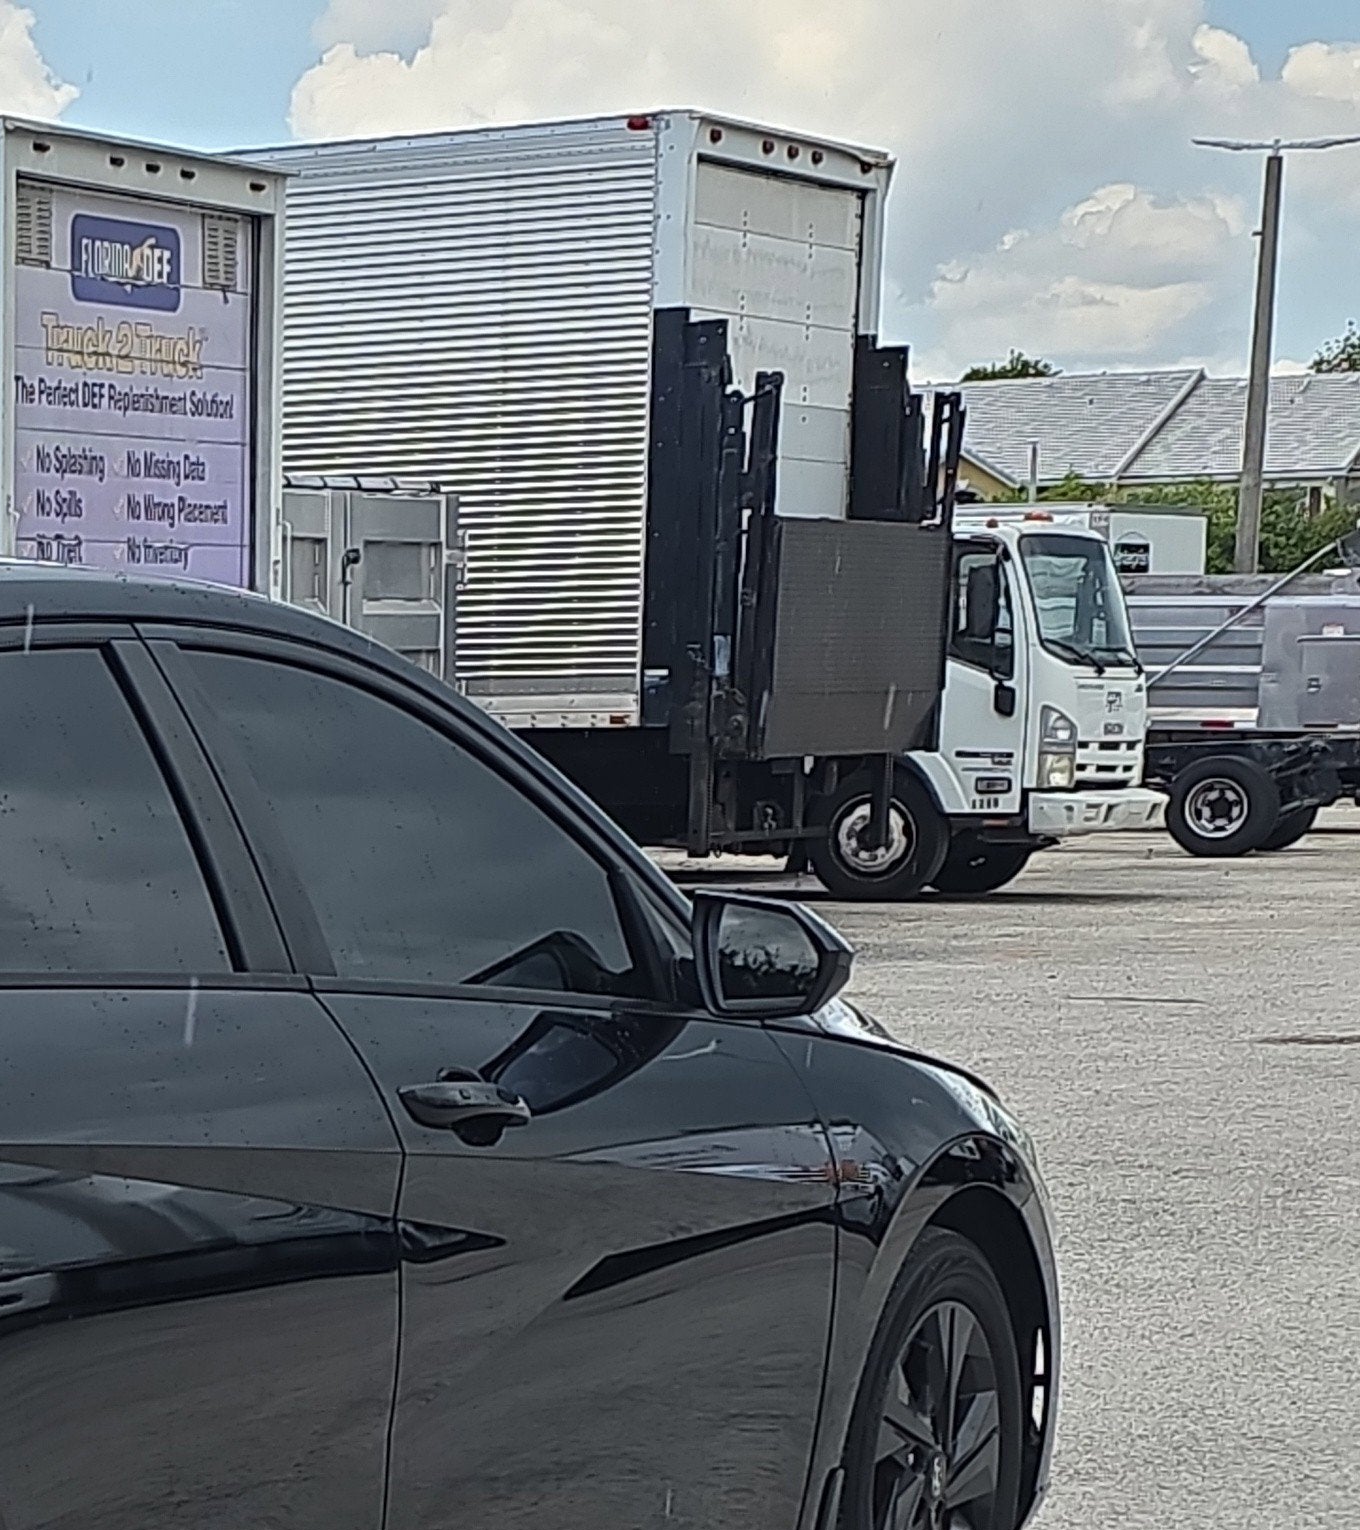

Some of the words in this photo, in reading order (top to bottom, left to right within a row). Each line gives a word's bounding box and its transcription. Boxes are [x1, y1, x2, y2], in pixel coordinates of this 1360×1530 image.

[143, 247, 172, 284] DEF
[41, 311, 113, 371] Truck
[115, 320, 135, 374] 2
[135, 322, 204, 380] Truck
[14, 375, 35, 404] The
[38, 378, 79, 408] Perfect
[82, 380, 105, 409] DEF
[108, 384, 187, 417] Replenishment
[36, 445, 51, 473] No
[53, 445, 105, 483] Splashing
[127, 450, 141, 478] No
[144, 450, 181, 487] Missing
[183, 454, 206, 481] Data
[36, 489, 51, 517] No
[53, 488, 83, 524] Spills
[127, 493, 141, 521] No
[144, 493, 175, 528] Wrong
[127, 536, 141, 563] No
